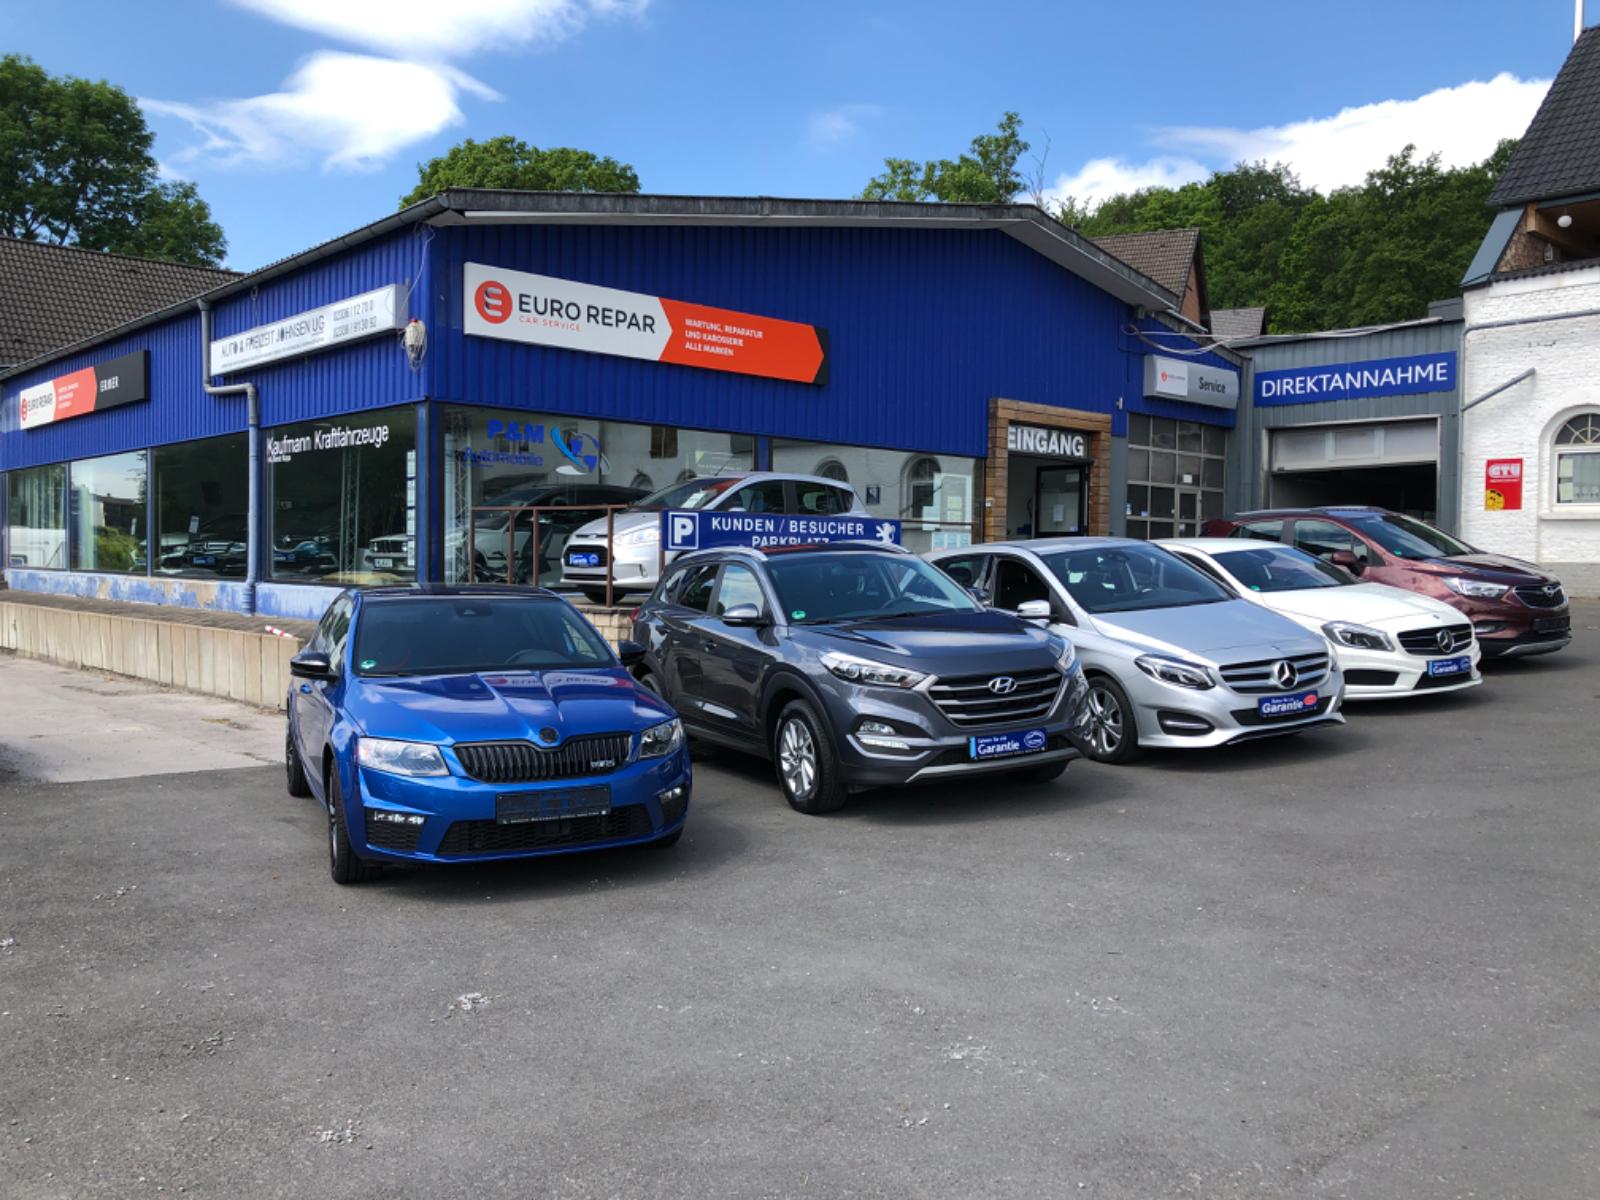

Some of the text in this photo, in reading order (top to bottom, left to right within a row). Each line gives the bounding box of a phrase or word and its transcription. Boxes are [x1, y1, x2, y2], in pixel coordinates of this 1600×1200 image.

[312, 314, 325, 333] UG
[518, 293, 656, 334] EURO REPAR
[519, 315, 582, 332] CAR SERVICE
[685, 341, 702, 352] ALLE
[1198, 376, 1226, 394] Service
[1261, 362, 1449, 398] DIREKTANNAHME
[266, 425, 389, 457] Kaufmann Kraftfahrzeuge
[487, 419, 545, 444] P&M
[1008, 425, 1084, 457] EINGANG
[673, 517, 694, 544] P
[711, 516, 774, 533] KUNDEN
[789, 519, 864, 536] BESUCHER
[1262, 700, 1304, 714] Garantie
[977, 740, 1020, 755] Garantie
